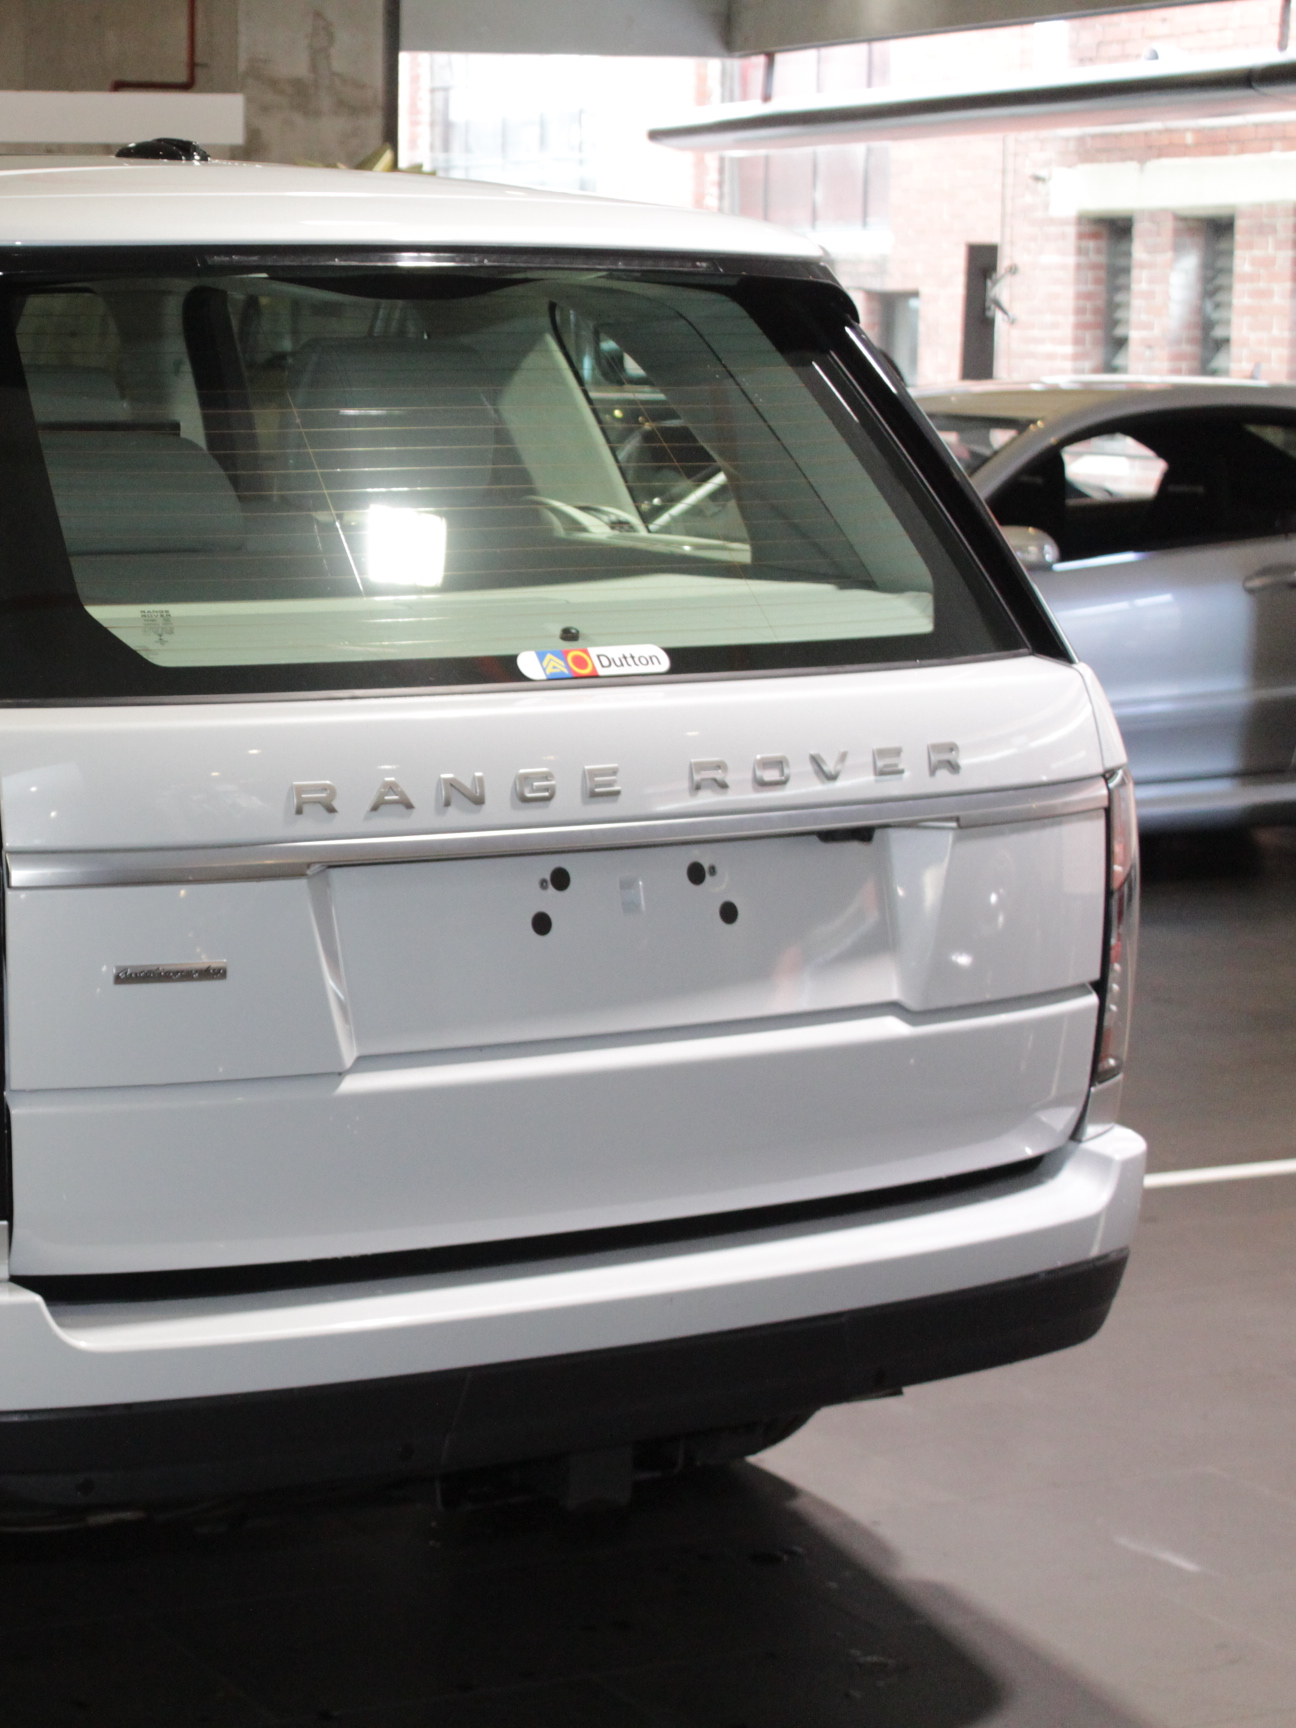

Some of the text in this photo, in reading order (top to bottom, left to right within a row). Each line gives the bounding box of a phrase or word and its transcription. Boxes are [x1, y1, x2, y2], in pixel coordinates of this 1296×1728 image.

[596, 653, 661, 669] Dutton
[291, 741, 962, 815] RANGE ROVER
